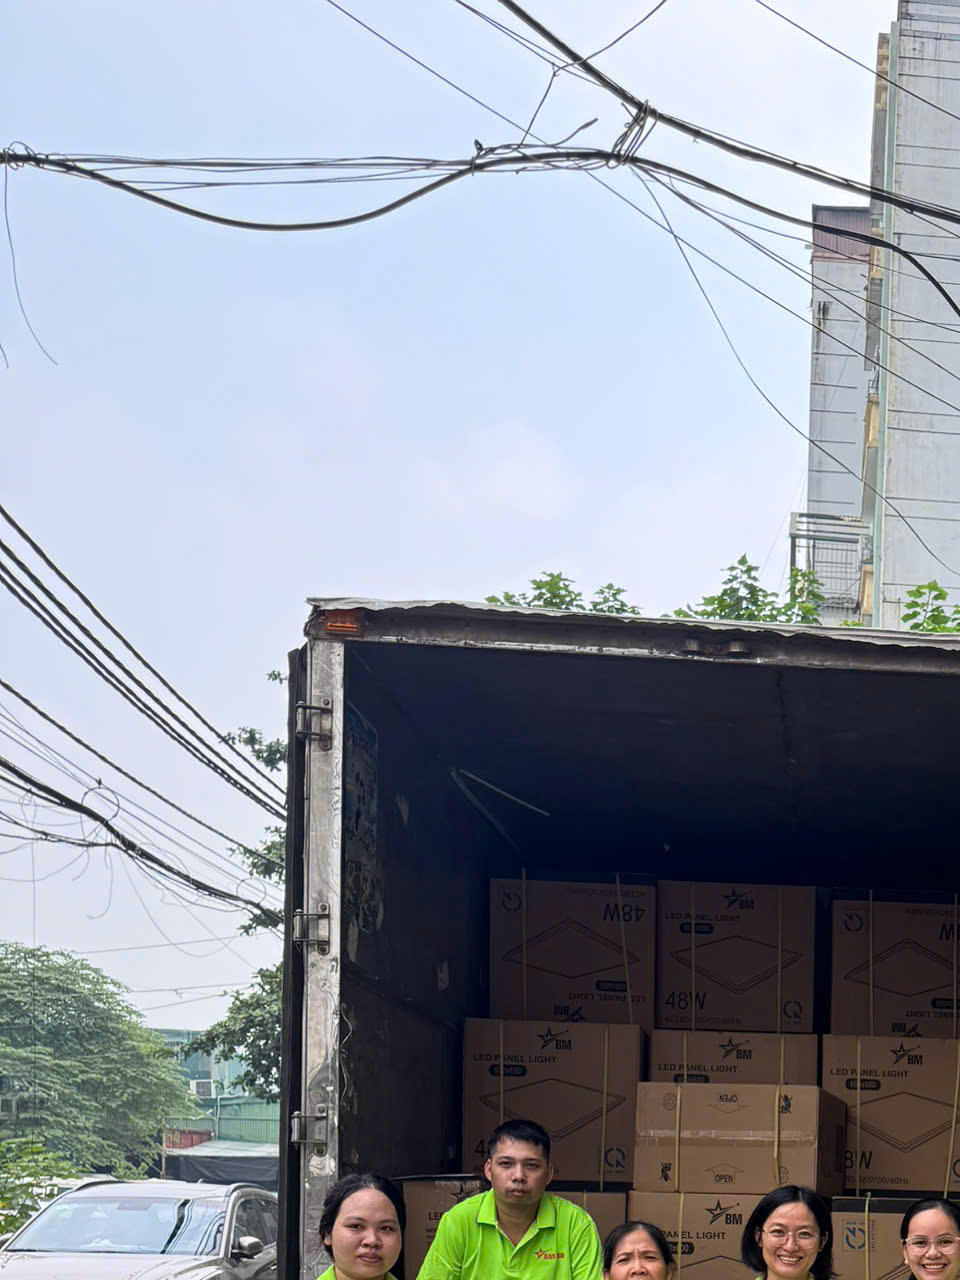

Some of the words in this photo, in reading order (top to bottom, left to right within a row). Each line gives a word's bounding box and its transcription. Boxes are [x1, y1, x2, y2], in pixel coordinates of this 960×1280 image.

[739, 900, 755, 910] BM
[603, 903, 647, 923] 48W
[664, 991, 707, 1011] 48W
[553, 1003, 570, 1017] BM
[905, 1010, 930, 1018] LIGHT
[891, 1022, 907, 1033] BM
[555, 1039, 572, 1051] BM
[473, 1054, 492, 1062] LED
[528, 1055, 557, 1064] LIGHT
[736, 1049, 752, 1060] BM
[907, 1054, 923, 1065] BM
[710, 1065, 738, 1073] LIGHT
[830, 1068, 848, 1076] LED
[882, 1070, 909, 1078] LIGHT
[719, 1095, 738, 1103] OPEN
[715, 1174, 733, 1183] OPEN
[725, 1213, 743, 1225] BM
[696, 1231, 727, 1240] LIGHT
